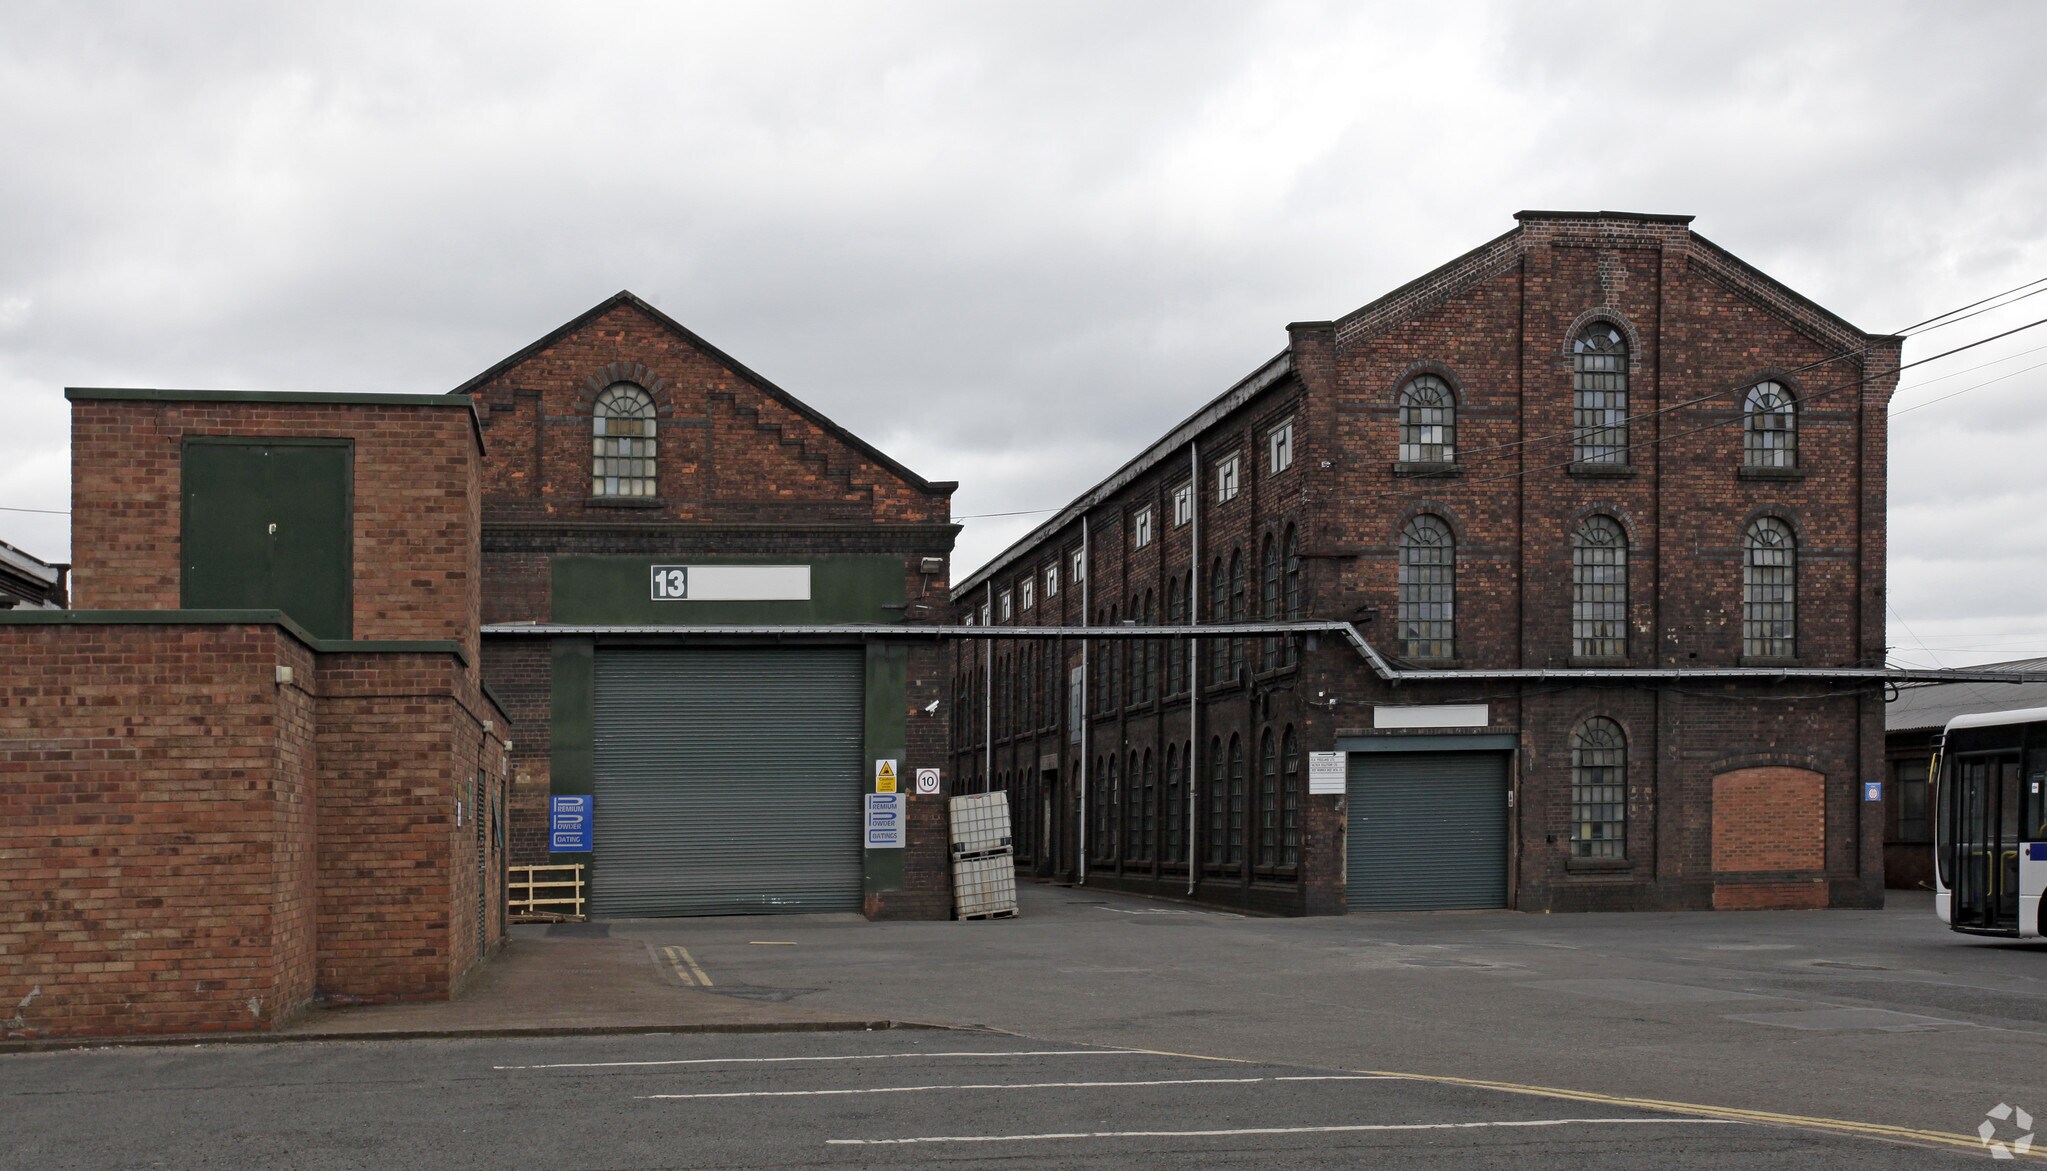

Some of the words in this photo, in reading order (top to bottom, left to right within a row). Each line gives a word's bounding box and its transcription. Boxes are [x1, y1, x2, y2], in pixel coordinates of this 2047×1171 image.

[655, 570, 685, 597] 13
[921, 776, 935, 787] 10
[553, 797, 584, 812] PREMIUM
[869, 795, 897, 810] PREMIUM
[869, 812, 897, 827] POWDER
[553, 832, 584, 847] COATING
[869, 829, 898, 843] COATINGS
